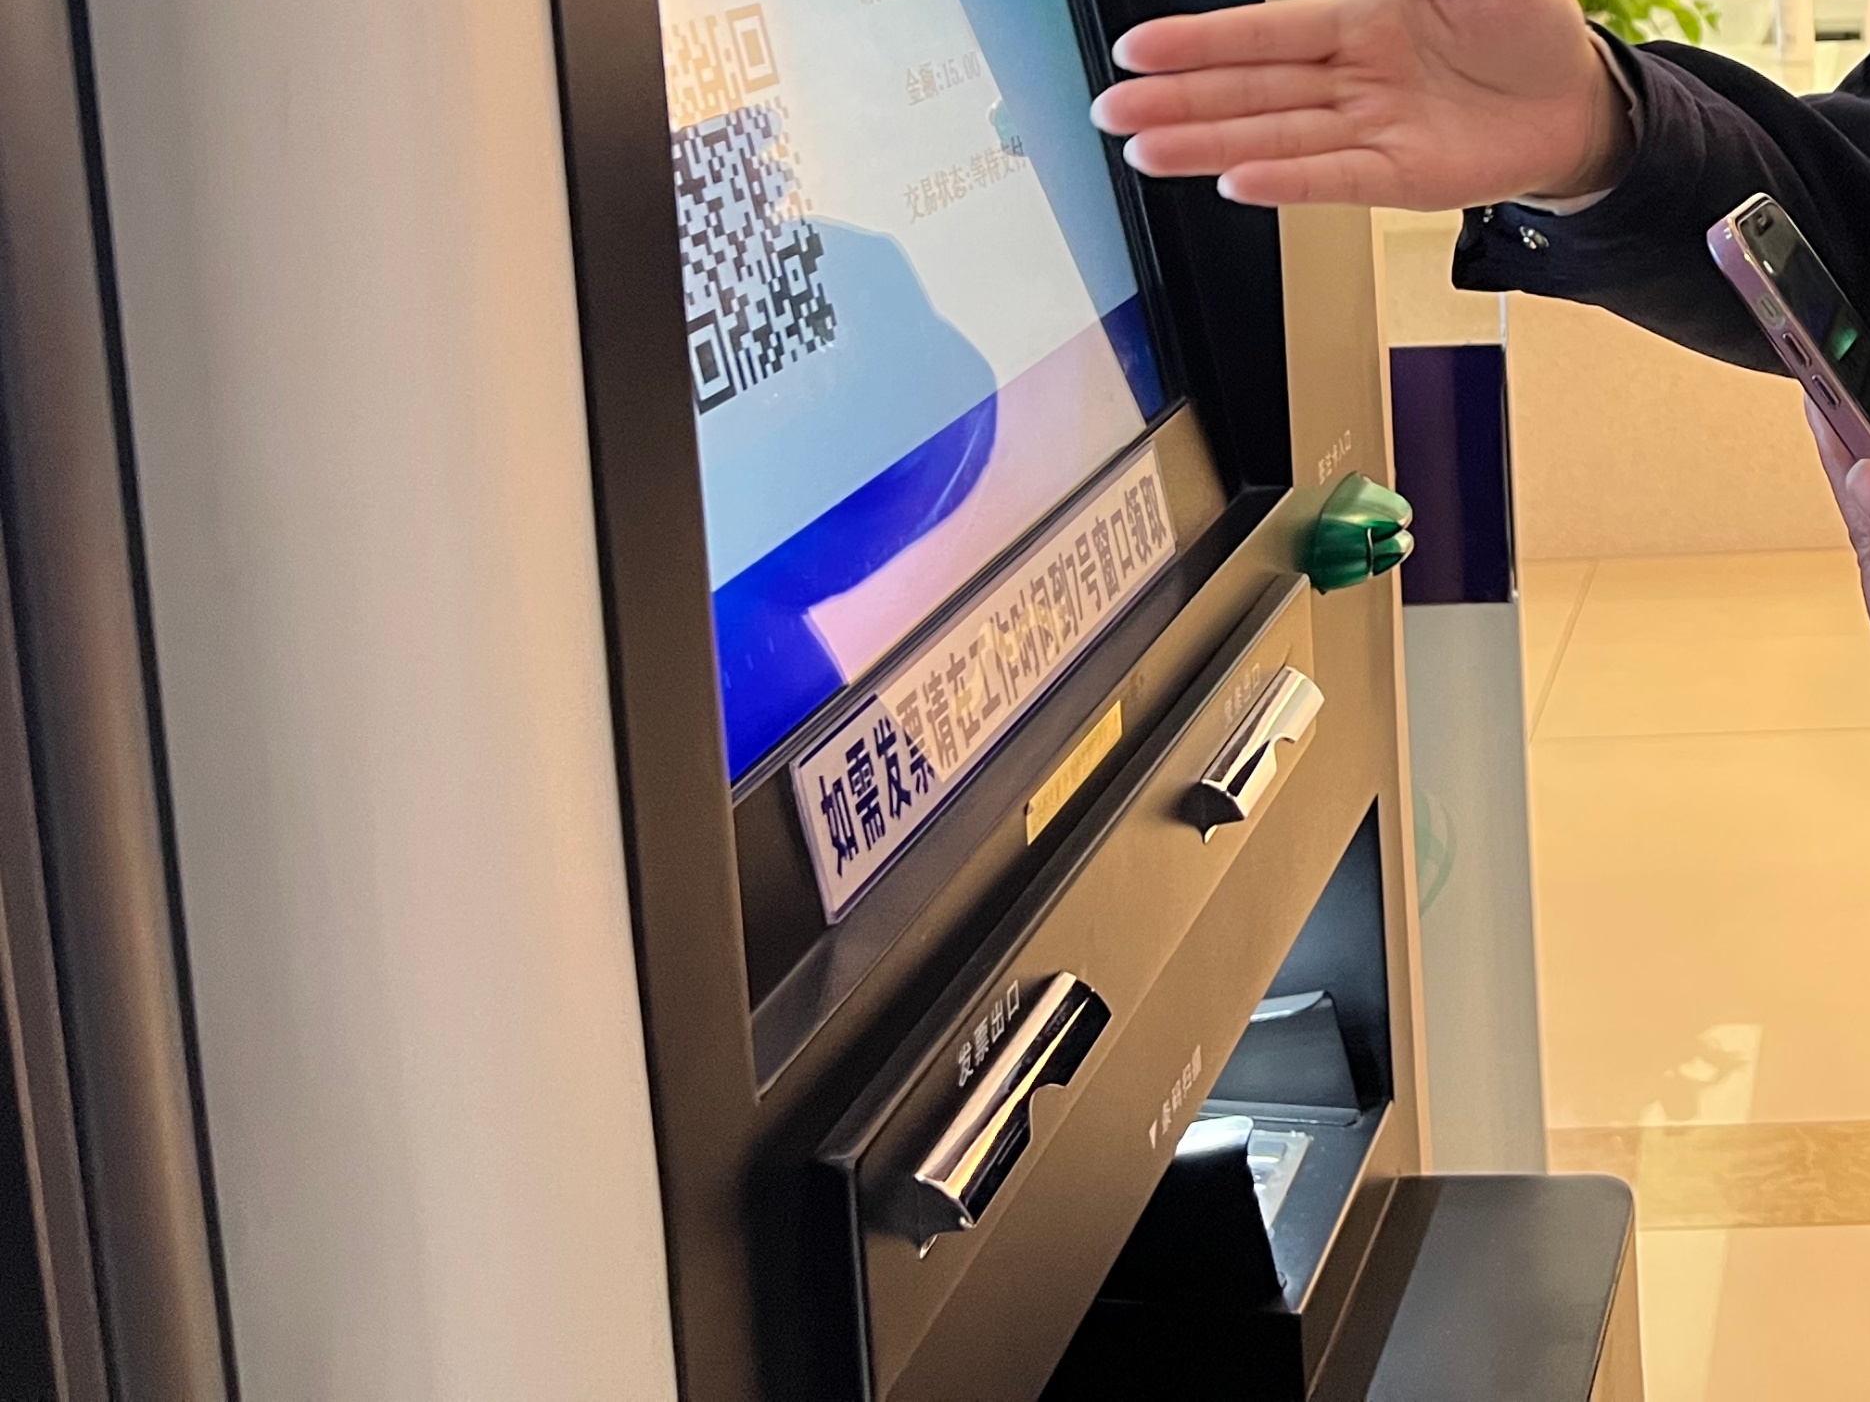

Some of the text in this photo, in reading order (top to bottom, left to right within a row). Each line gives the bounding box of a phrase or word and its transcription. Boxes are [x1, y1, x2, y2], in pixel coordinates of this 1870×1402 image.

[819, 472, 1168, 878] 如需发票请在工作时间到7号窗口领取
[958, 979, 1020, 1088] 发票出口
